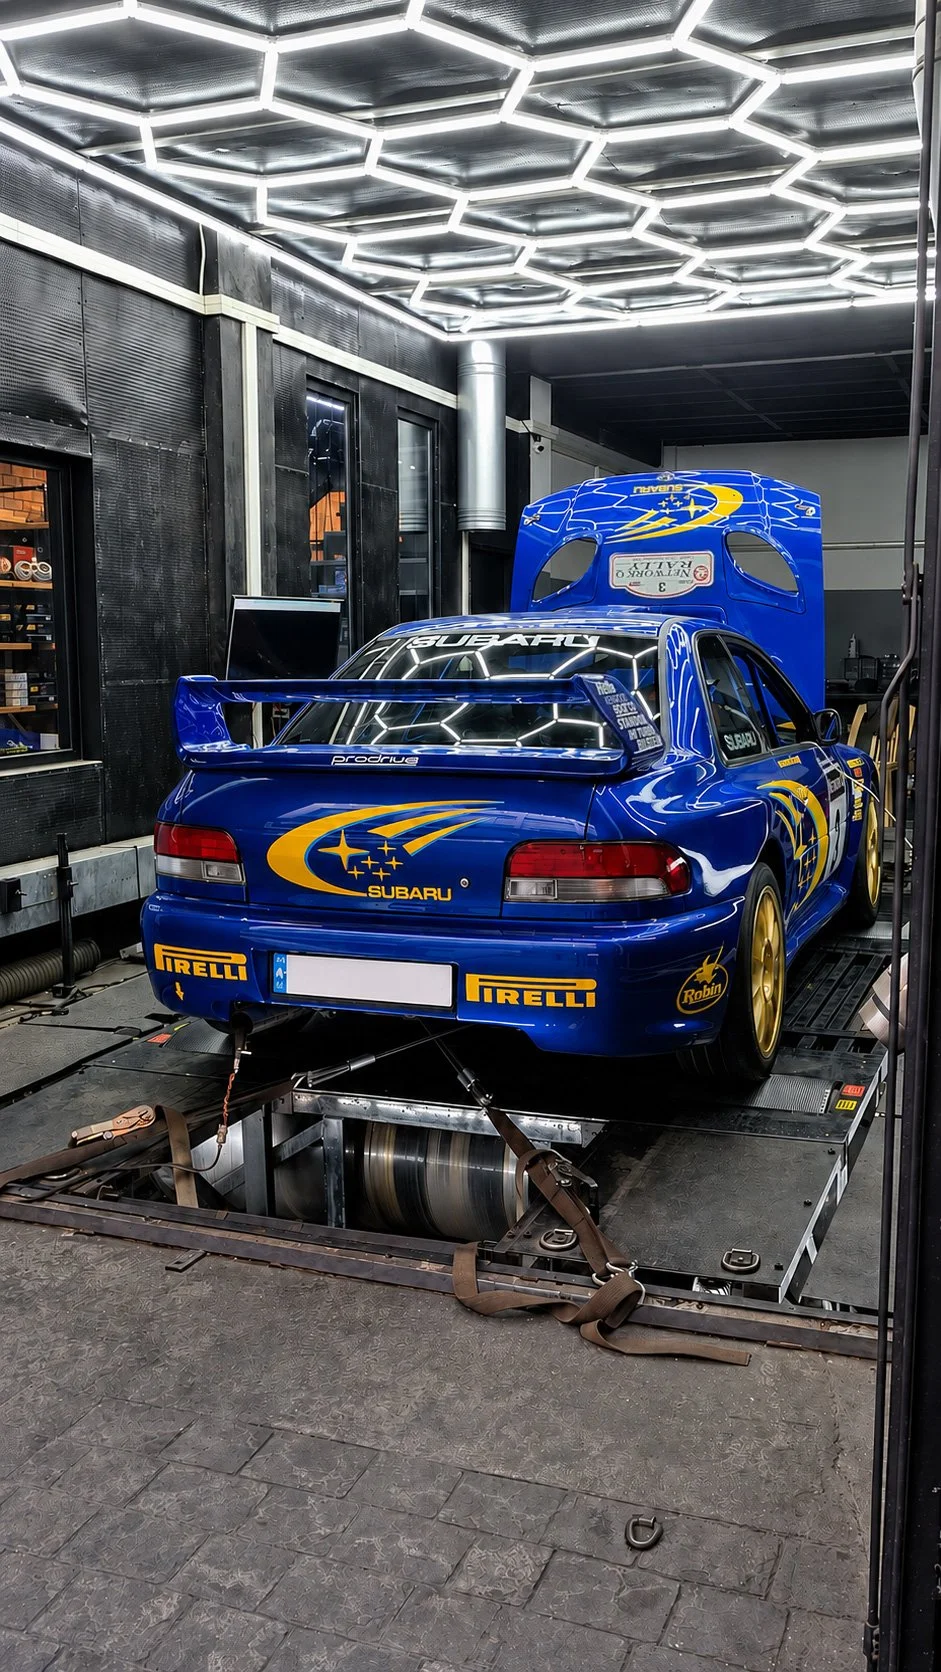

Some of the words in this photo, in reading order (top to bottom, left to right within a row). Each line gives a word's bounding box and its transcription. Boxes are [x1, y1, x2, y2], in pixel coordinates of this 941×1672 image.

[634, 484, 683, 494] SUBARU
[630, 560, 693, 571] RALLY
[616, 570, 624, 579] Q
[627, 569, 690, 578] NETWORK
[658, 582, 666, 593] 3
[407, 634, 600, 650] SUBARU
[724, 731, 757, 751] SUBARU
[331, 754, 420, 767] prodrive
[368, 885, 452, 902] SUBARU
[154, 943, 248, 981] PIRELLI
[465, 973, 598, 1008] PIRELLI
[682, 983, 721, 1004] Robin
